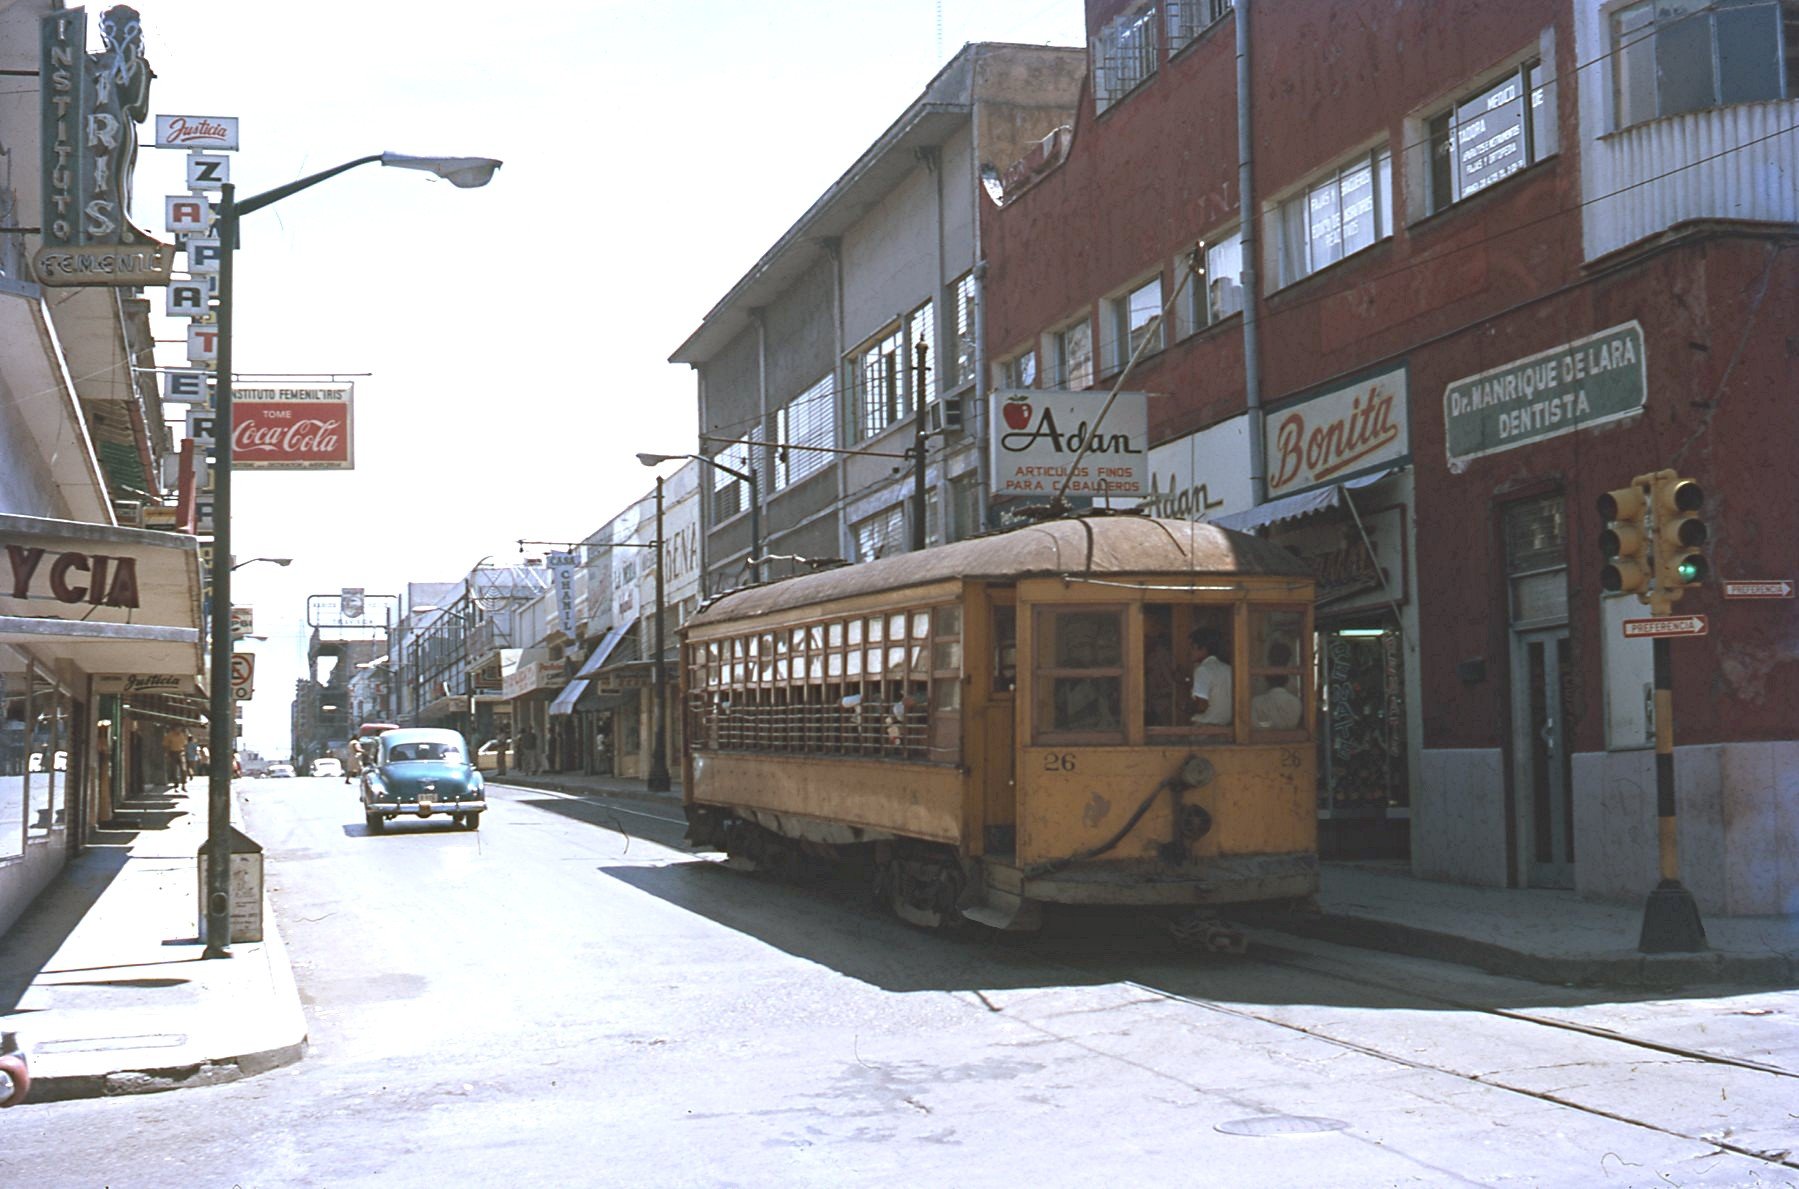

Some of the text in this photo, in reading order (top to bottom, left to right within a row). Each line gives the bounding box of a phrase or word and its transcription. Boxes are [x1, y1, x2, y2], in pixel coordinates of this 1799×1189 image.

[51, 19, 73, 241] INSTITUTO
[166, 118, 228, 143] Justicia
[84, 70, 118, 236] IRIS
[172, 160, 223, 523] ZAPATERA
[1451, 337, 1637, 417] Dr. MANRIQUE DE LARA
[231, 389, 276, 400] NSTITUTO
[279, 389, 318, 401] FEMENIL
[263, 410, 293, 419] TOME
[1001, 406, 1143, 454] Adan
[1499, 391, 1590, 439] DENTISTA
[231, 419, 341, 453] Coca-Cola
[1269, 384, 1398, 490] Bonita
[1006, 480, 1044, 491] PARA
[1015, 466, 1133, 478] ARTICULOS FINOS
[1136, 472, 1224, 519] Adan
[6, 544, 46, 600] Y
[51, 551, 141, 609] CIA
[1731, 585, 1783, 595] PREFERENCIA
[1631, 622, 1694, 633] PREFERENCIA
[123, 674, 180, 692] Justicia
[1044, 752, 1076, 771] 26
